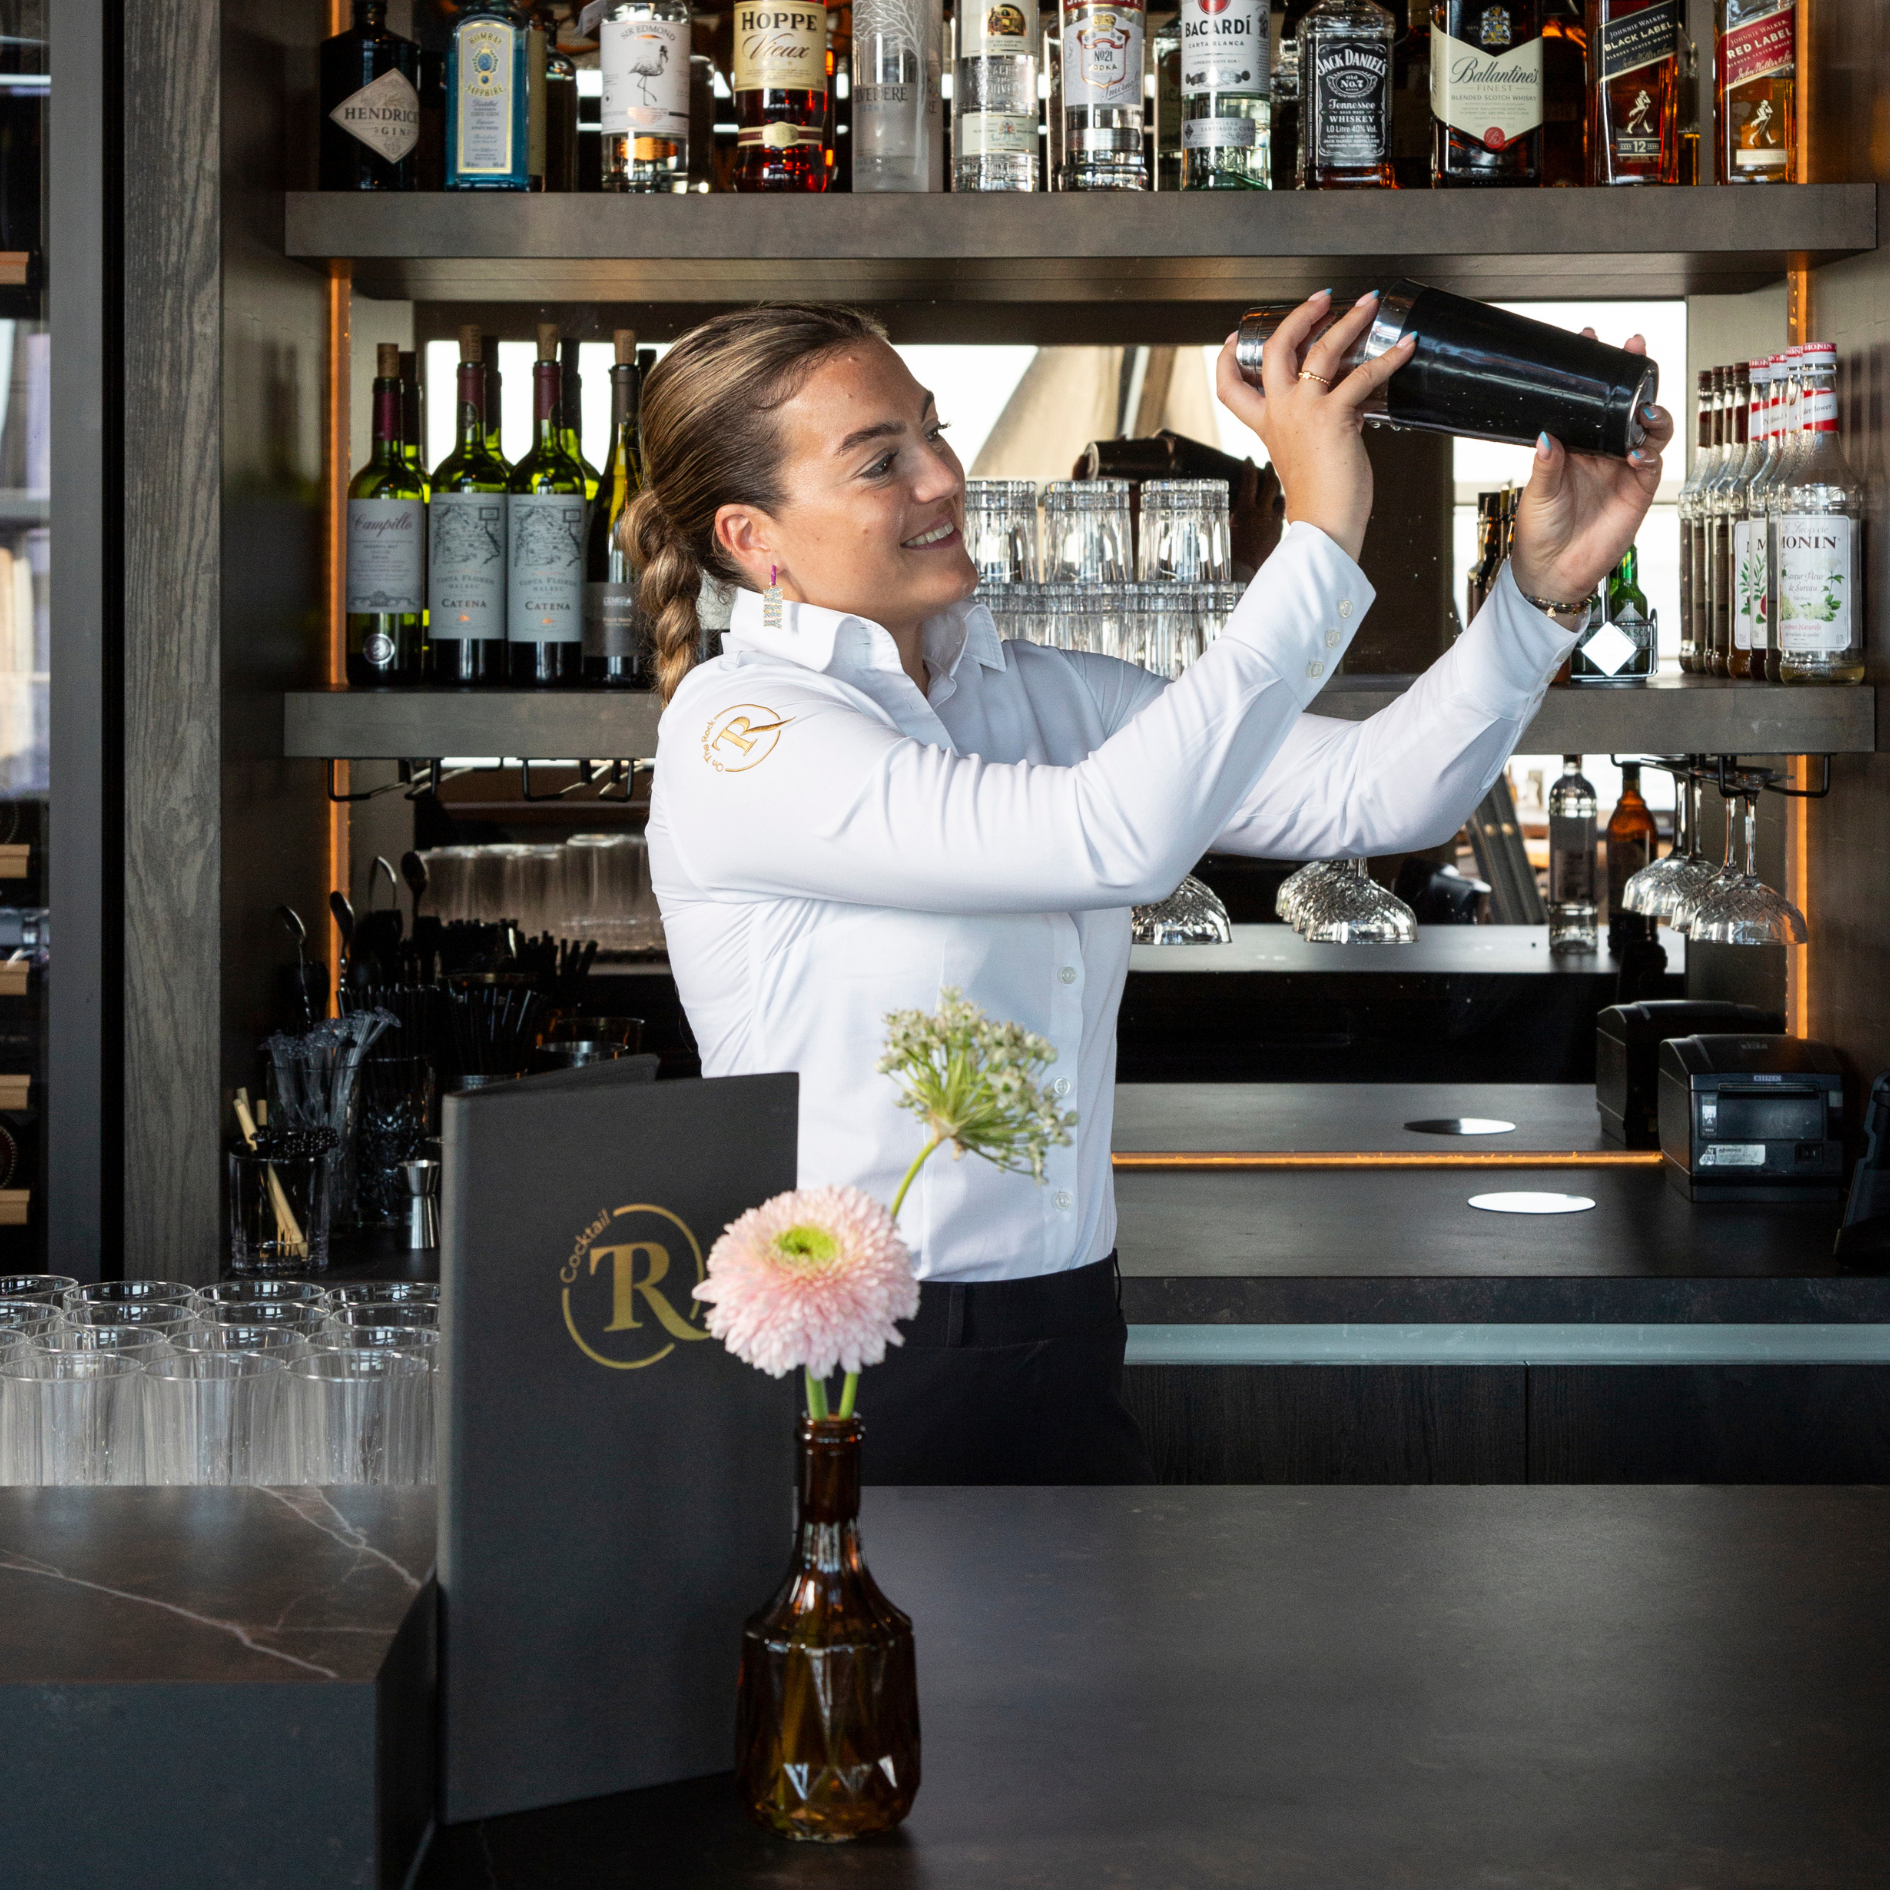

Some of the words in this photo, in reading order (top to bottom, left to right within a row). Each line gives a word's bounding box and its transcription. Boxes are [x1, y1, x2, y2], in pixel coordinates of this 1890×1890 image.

[741, 11, 817, 31] HOPPE
[1185, 14, 1251, 37] BACARDÍ
[468, 32, 503, 48] BOMBAY
[621, 28, 636, 39] SIR
[636, 25, 676, 41] EDMOND
[1604, 33, 1639, 52] BLACK
[1640, 21, 1673, 38] LABEL
[742, 33, 810, 59] Vieux
[1188, 41, 1209, 49] CARTA
[1727, 43, 1752, 59] RED
[1755, 27, 1792, 49] LABEL
[1317, 53, 1345, 76] JACK
[1344, 48, 1389, 77] DANIEL'S
[1449, 56, 1540, 84] Ballantine's
[467, 81, 504, 98] SAPPHIRE
[1328, 98, 1376, 109] Tennessee
[1329, 115, 1375, 123] WHISKEY
[381, 127, 406, 136] GIN
[1632, 141, 1646, 153] 12
[1804, 343, 1833, 352] MONIN
[701, 720, 715, 743] Rock
[559, 1208, 612, 1284] Cocktail
